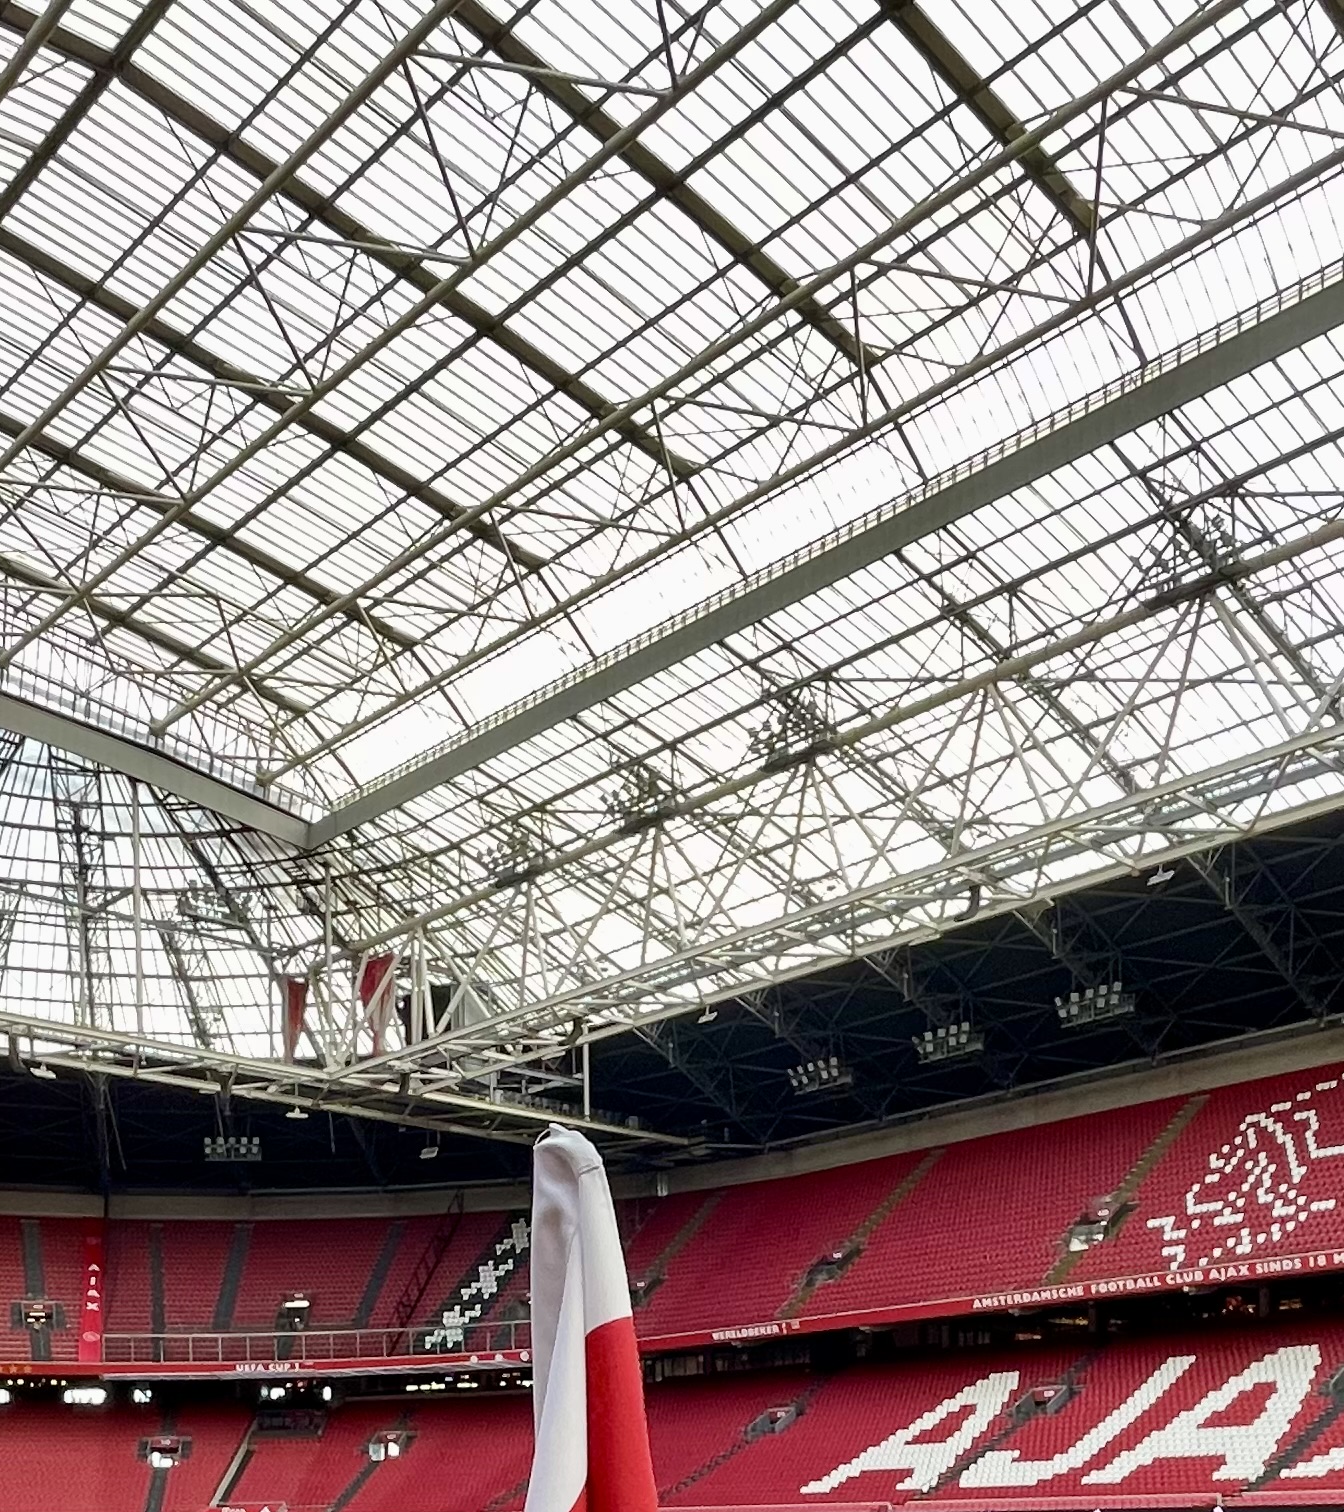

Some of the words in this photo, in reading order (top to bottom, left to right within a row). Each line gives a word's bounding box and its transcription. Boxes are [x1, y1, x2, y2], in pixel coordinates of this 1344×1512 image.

[972, 1285, 1084, 1309] AMSTERDAMSCHE
[1090, 1275, 1162, 1296] FOOTBALL
[1165, 1269, 1204, 1285] CLUB
[1208, 1263, 1250, 1282] AJAX
[1255, 1257, 1302, 1275] SINDS
[1308, 1254, 1327, 1268] 18
